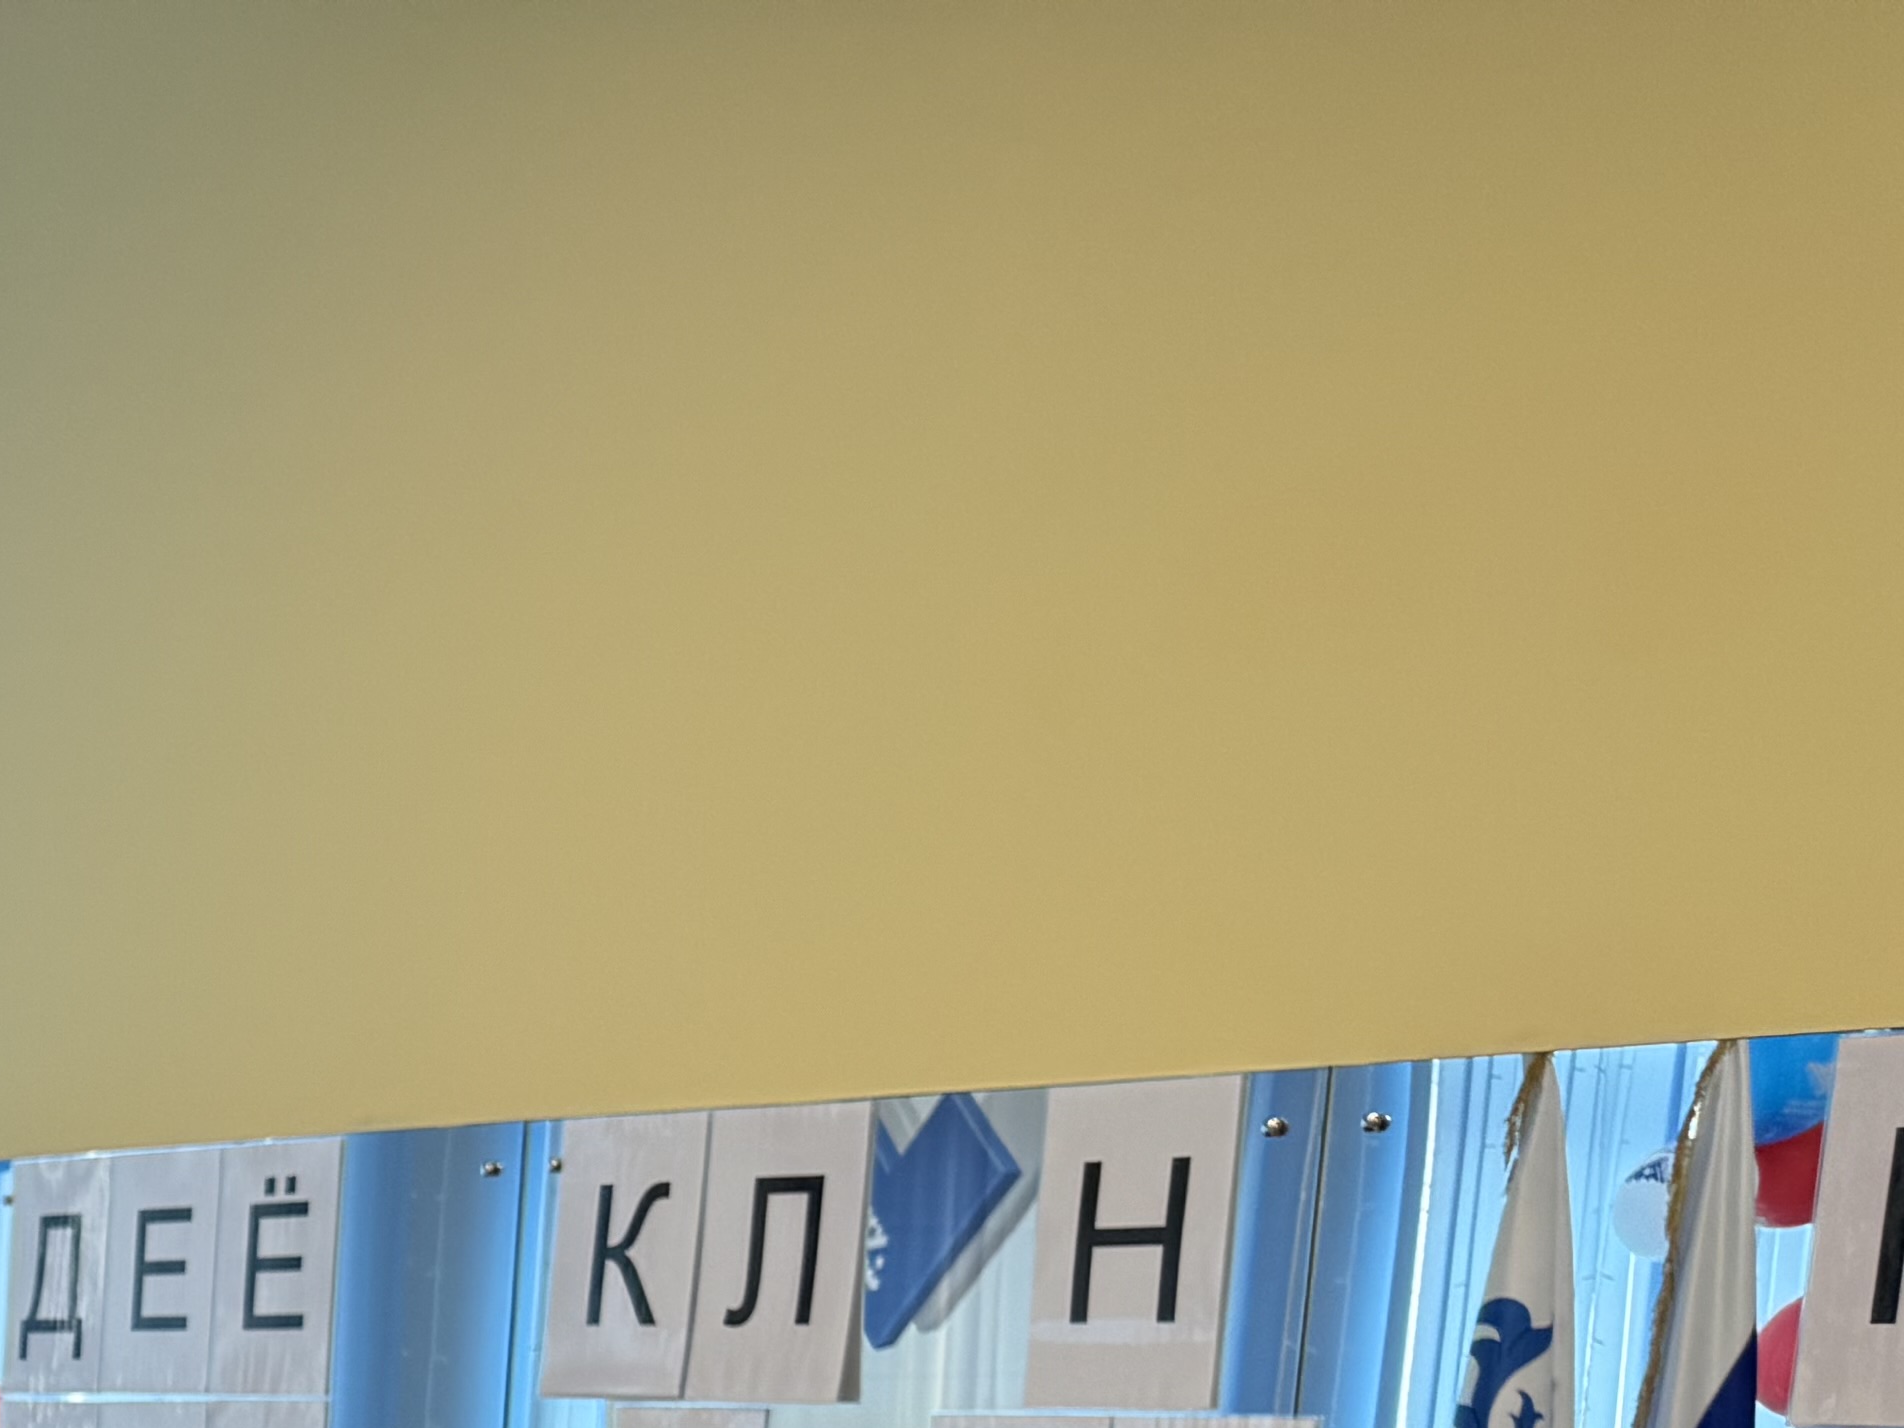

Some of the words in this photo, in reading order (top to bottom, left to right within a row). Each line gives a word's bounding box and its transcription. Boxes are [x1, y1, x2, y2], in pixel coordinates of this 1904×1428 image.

[18, 1213, 84, 1361] Д
[130, 1207, 193, 1332] Е
[241, 1174, 310, 1332] Ё
[585, 1180, 672, 1328] К
[723, 1174, 826, 1329] Л
[1068, 1156, 1193, 1326] Н
